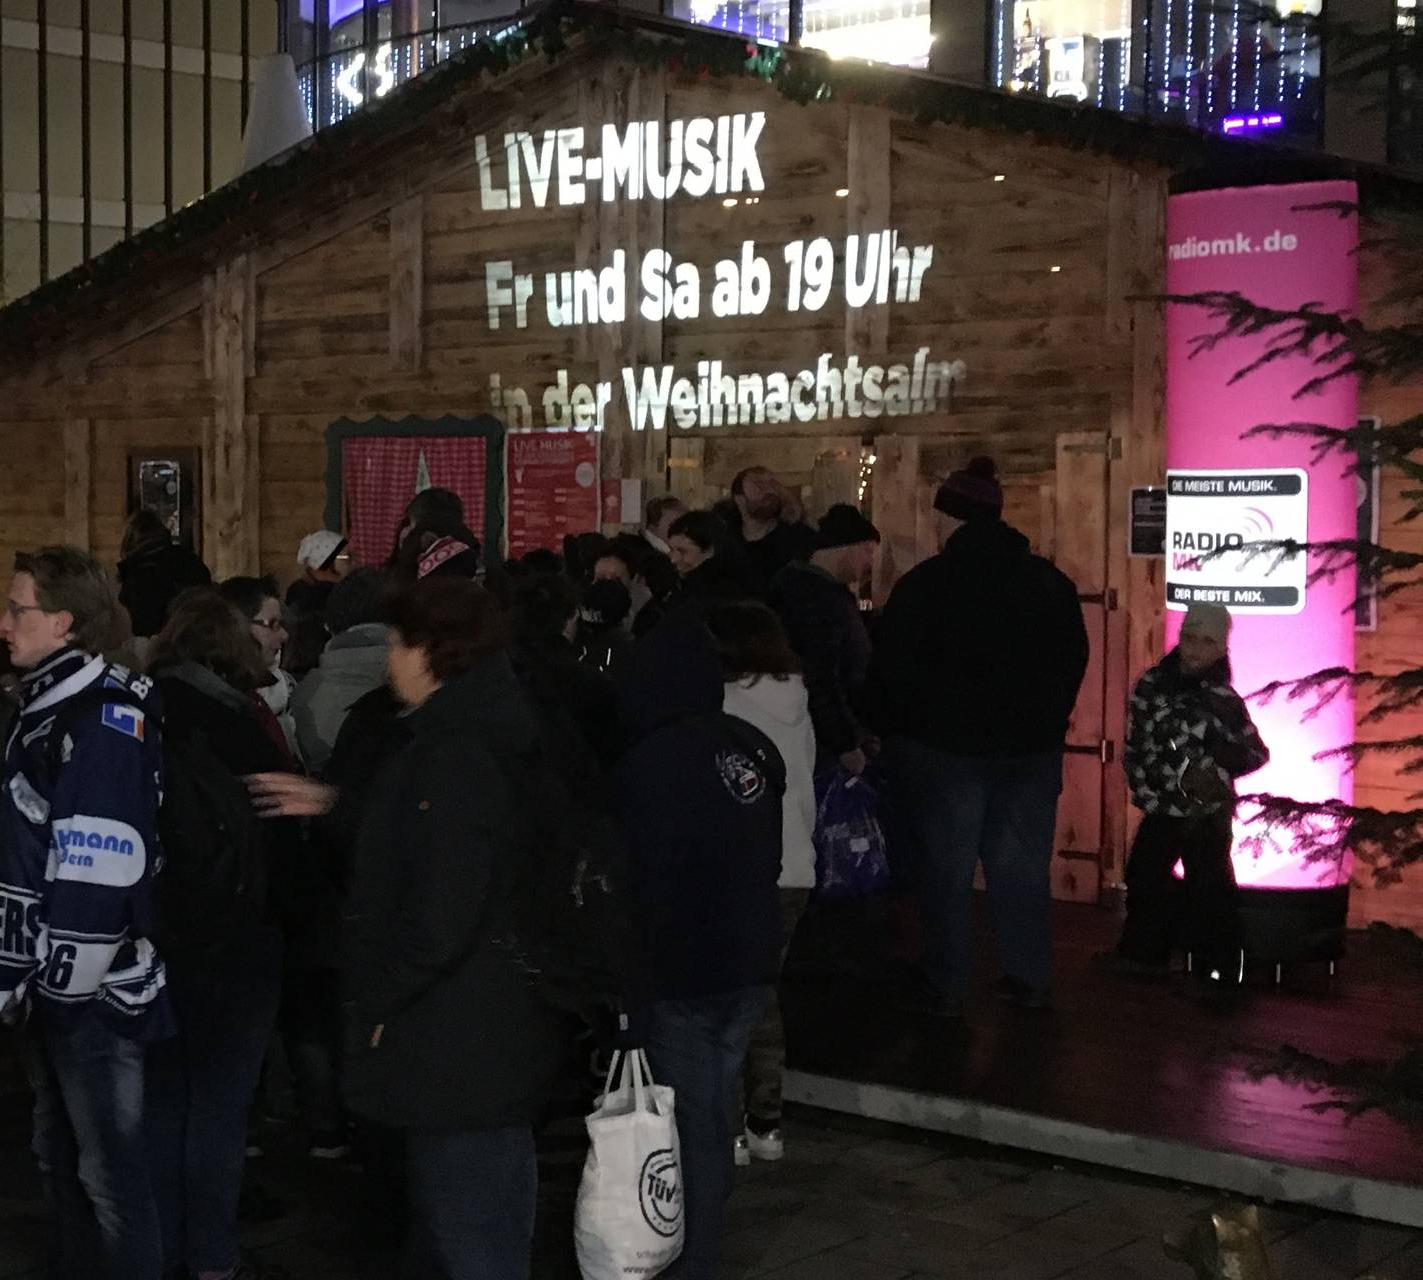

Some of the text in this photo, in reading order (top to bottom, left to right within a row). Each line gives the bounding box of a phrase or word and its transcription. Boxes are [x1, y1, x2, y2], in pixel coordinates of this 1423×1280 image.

[476, 112, 766, 211] LIVE-MUSIK
[1169, 229, 1298, 261] radiomk.de
[485, 230, 934, 329] Fr und Sa ab 19 Uhr
[489, 347, 966, 433] in der Weihnachtsalm
[1185, 479, 1225, 492] MEISTE
[1173, 531, 1244, 551] RADIO
[1193, 589, 1230, 602] BESTE
[647, 1174, 676, 1202] TÜV
